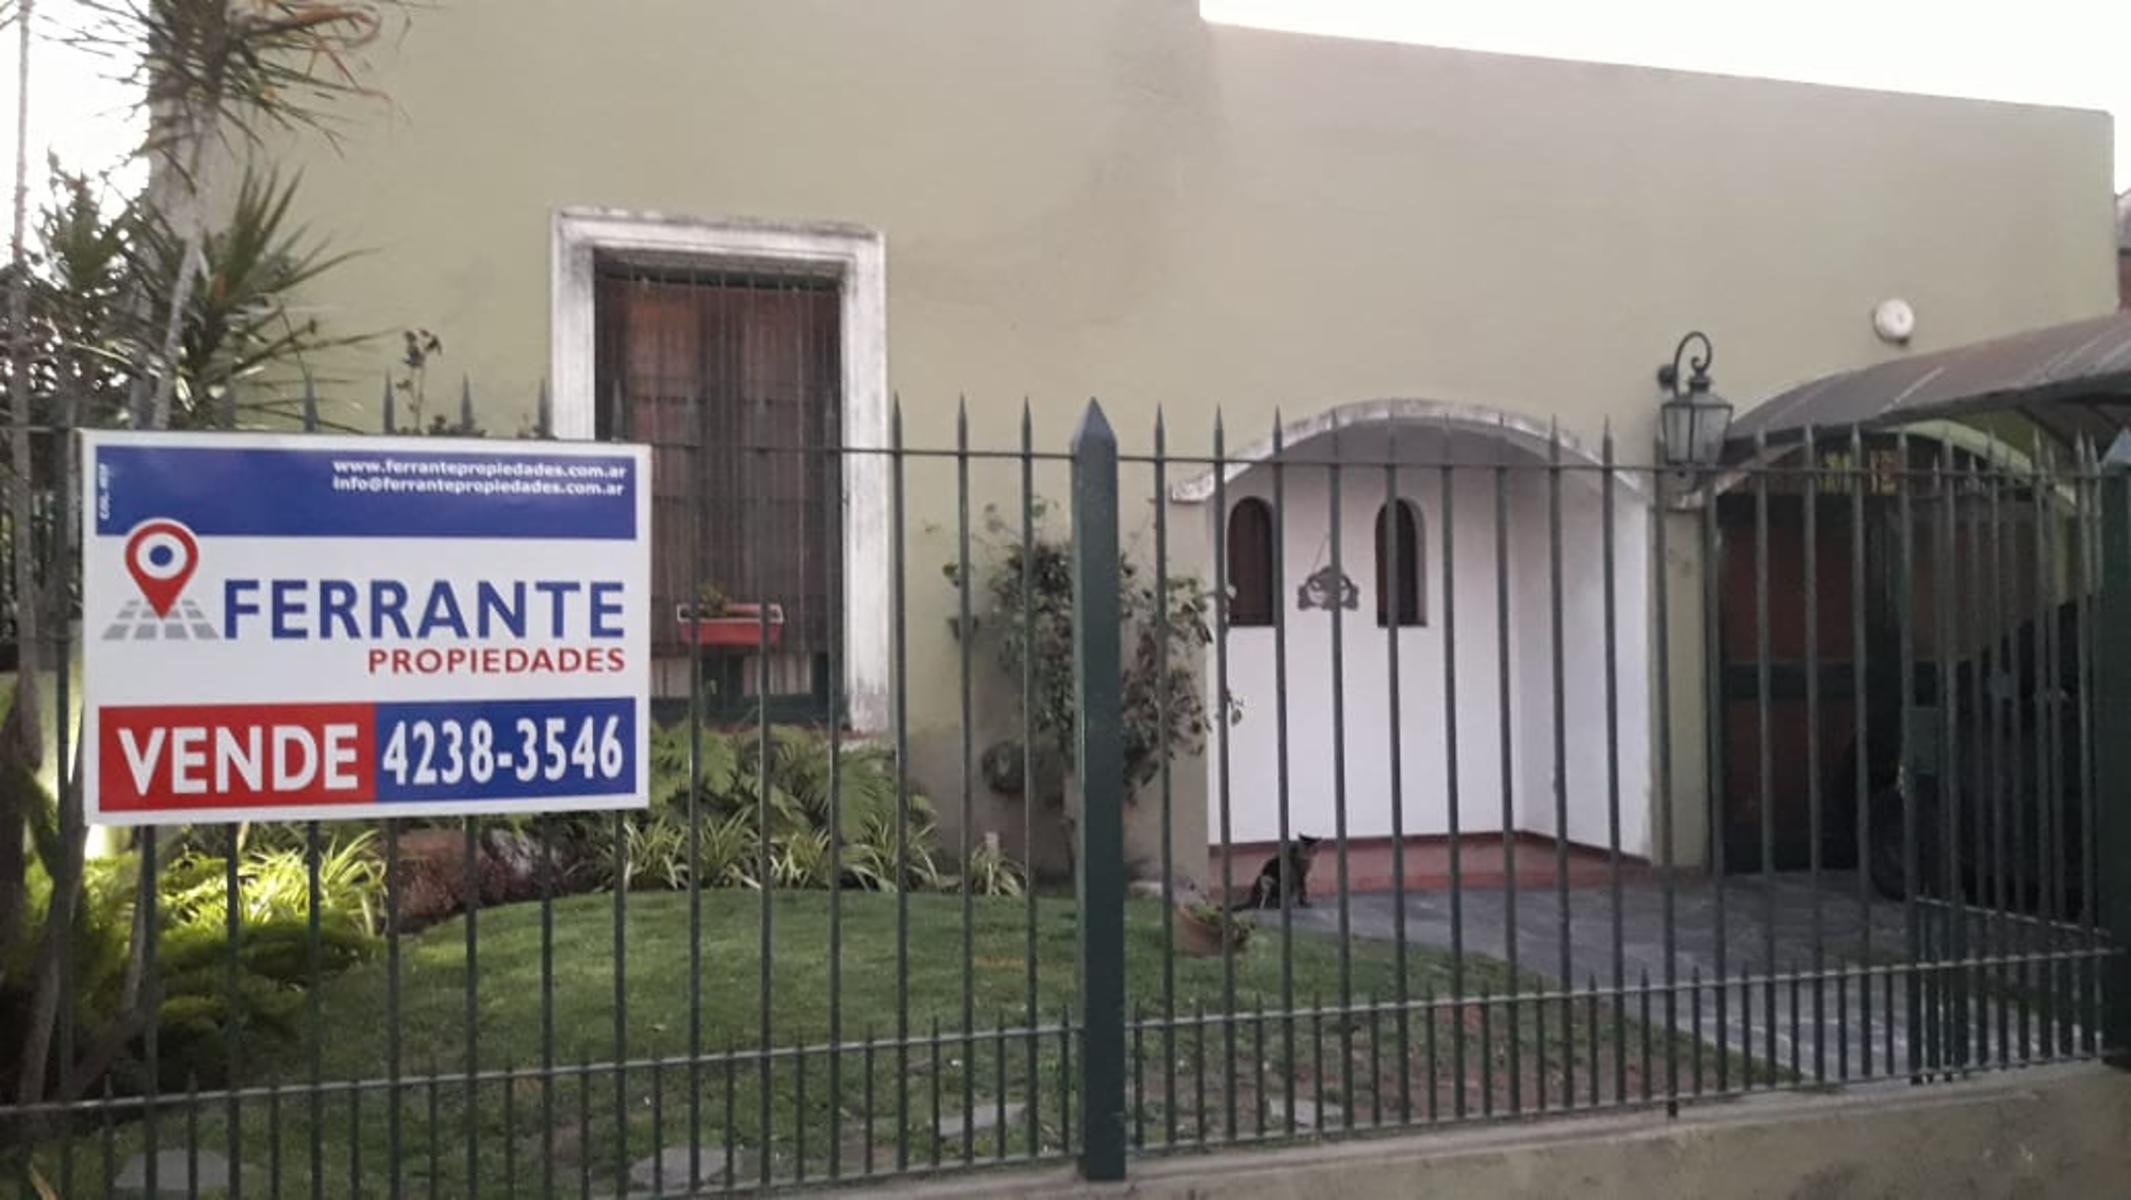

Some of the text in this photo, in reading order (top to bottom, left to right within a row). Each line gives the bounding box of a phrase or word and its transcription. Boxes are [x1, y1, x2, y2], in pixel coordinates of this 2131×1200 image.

[333, 459, 626, 478] www.ferrantepropiedades.com.ar
[333, 475, 624, 495] info@ferrantepropiedades.com.ar
[224, 579, 624, 640] FERRANTE
[368, 648, 625, 674] PROPIEDADES
[118, 716, 623, 796] VENDE 4238-3546
